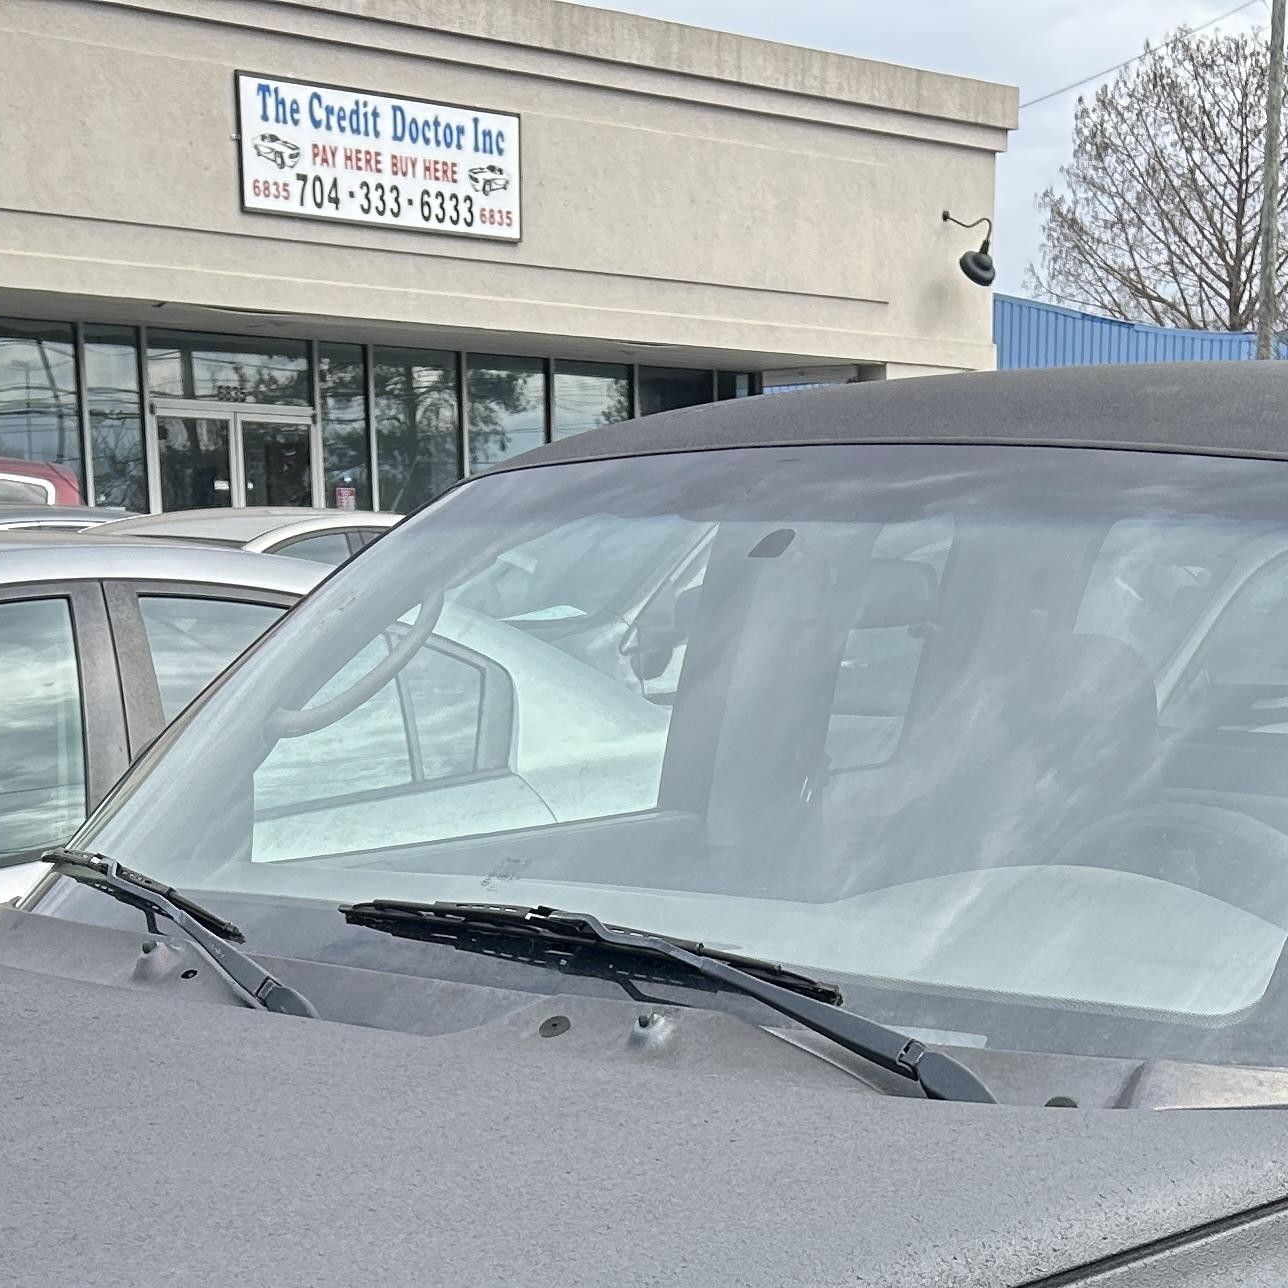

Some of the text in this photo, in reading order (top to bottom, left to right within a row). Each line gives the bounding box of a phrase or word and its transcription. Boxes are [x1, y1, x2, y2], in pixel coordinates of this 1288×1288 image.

[256, 83, 505, 156] The Credit Doctor Inc
[311, 144, 458, 183] PAY HERE BUY HERE
[252, 179, 290, 200] 6835
[479, 208, 513, 227] 6835
